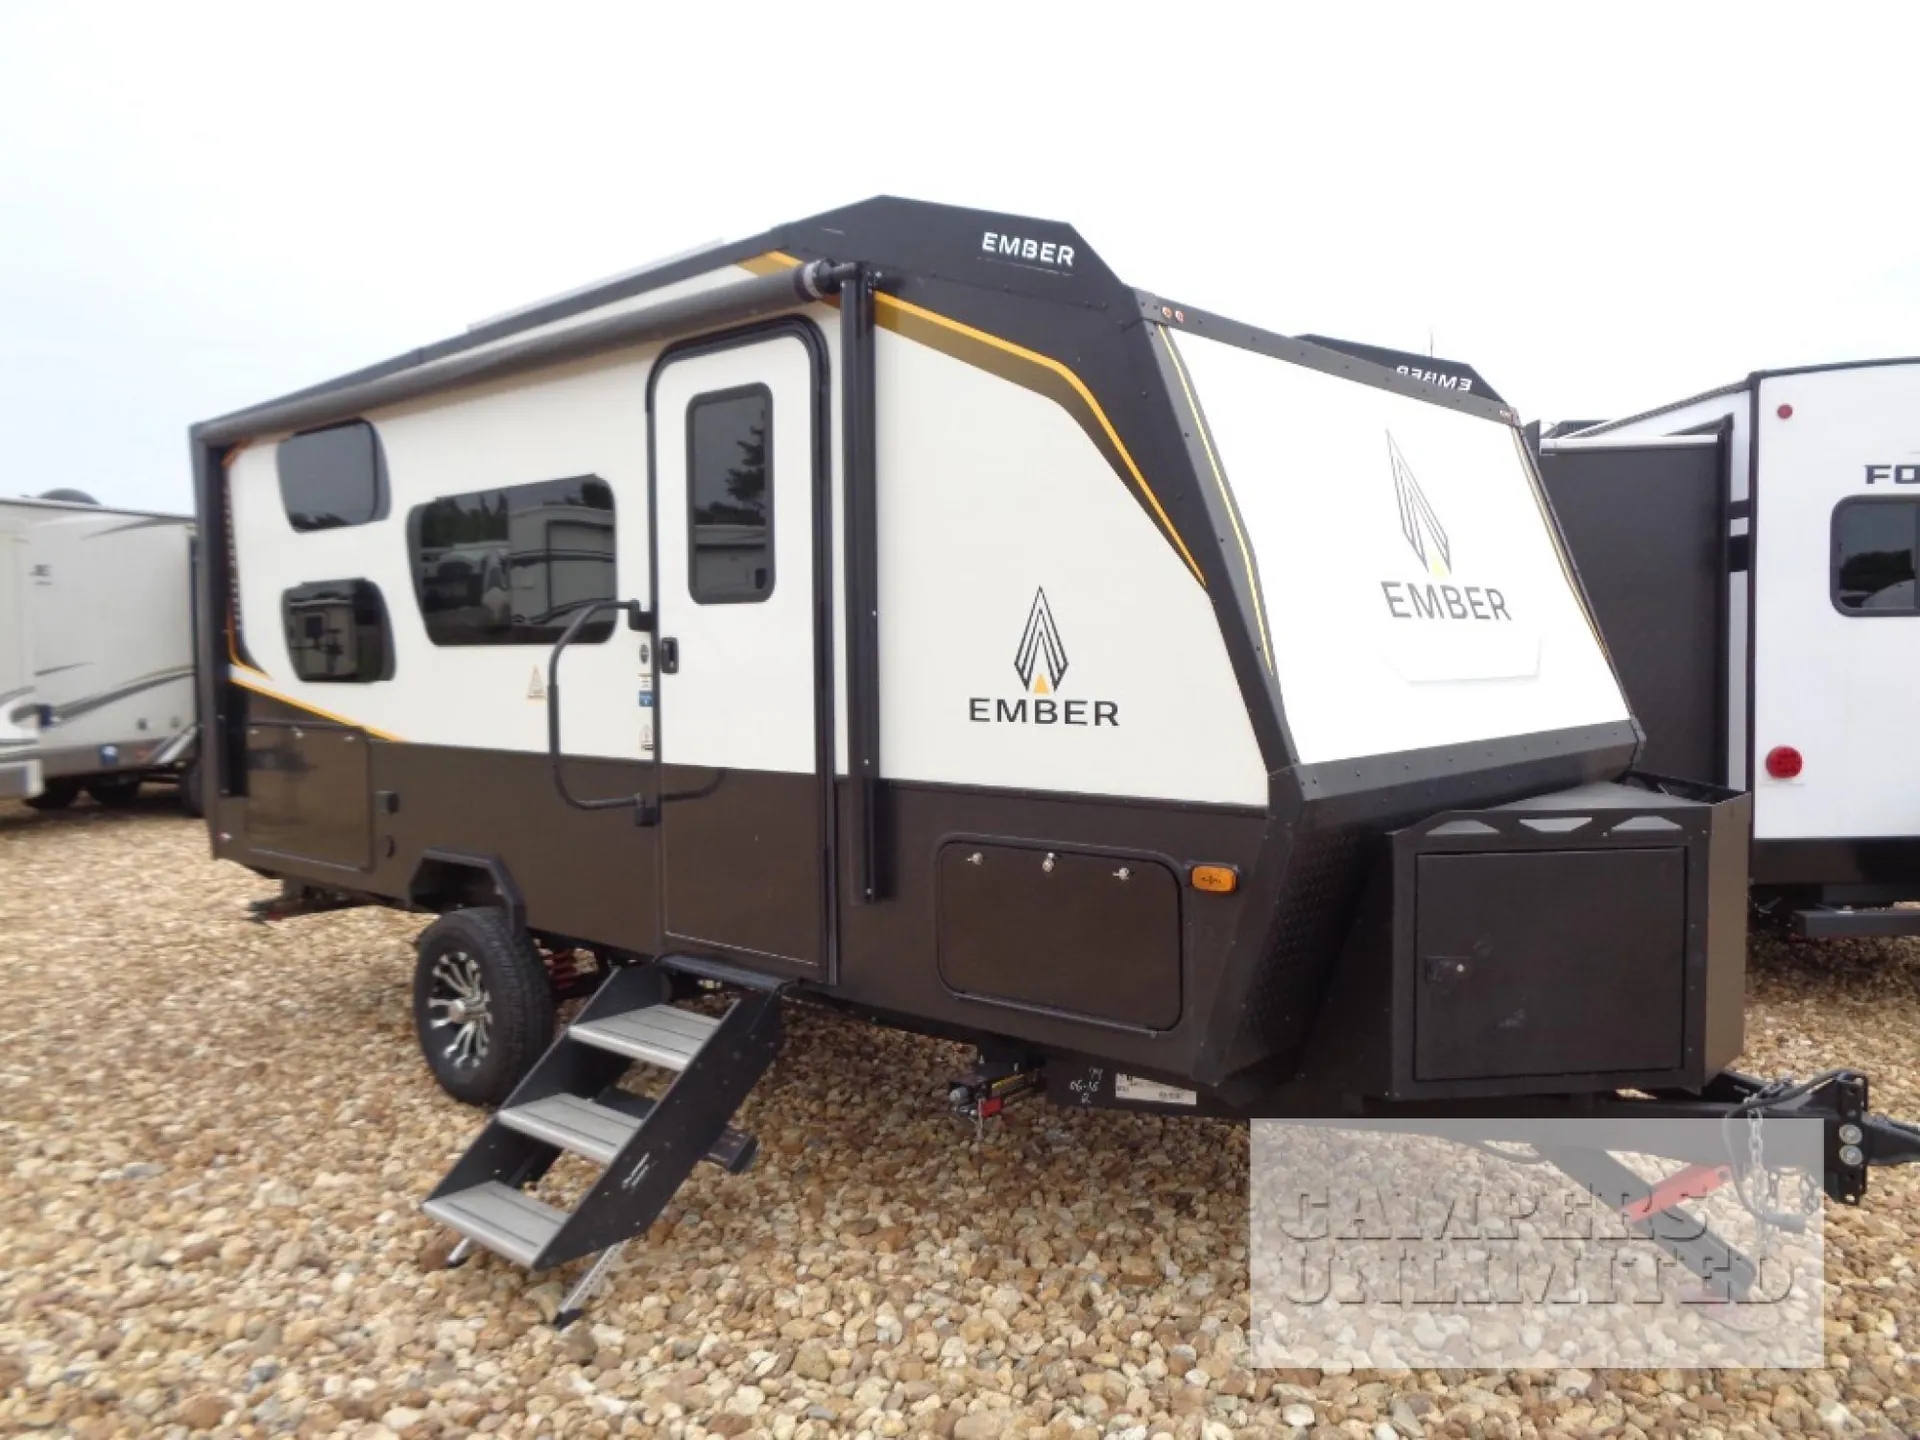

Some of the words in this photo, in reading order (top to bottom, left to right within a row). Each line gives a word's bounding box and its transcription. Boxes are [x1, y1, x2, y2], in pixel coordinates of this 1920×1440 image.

[982, 231, 1075, 267] EMBER
[1380, 580, 1512, 621] EMBER
[969, 697, 1119, 727] EMBER
